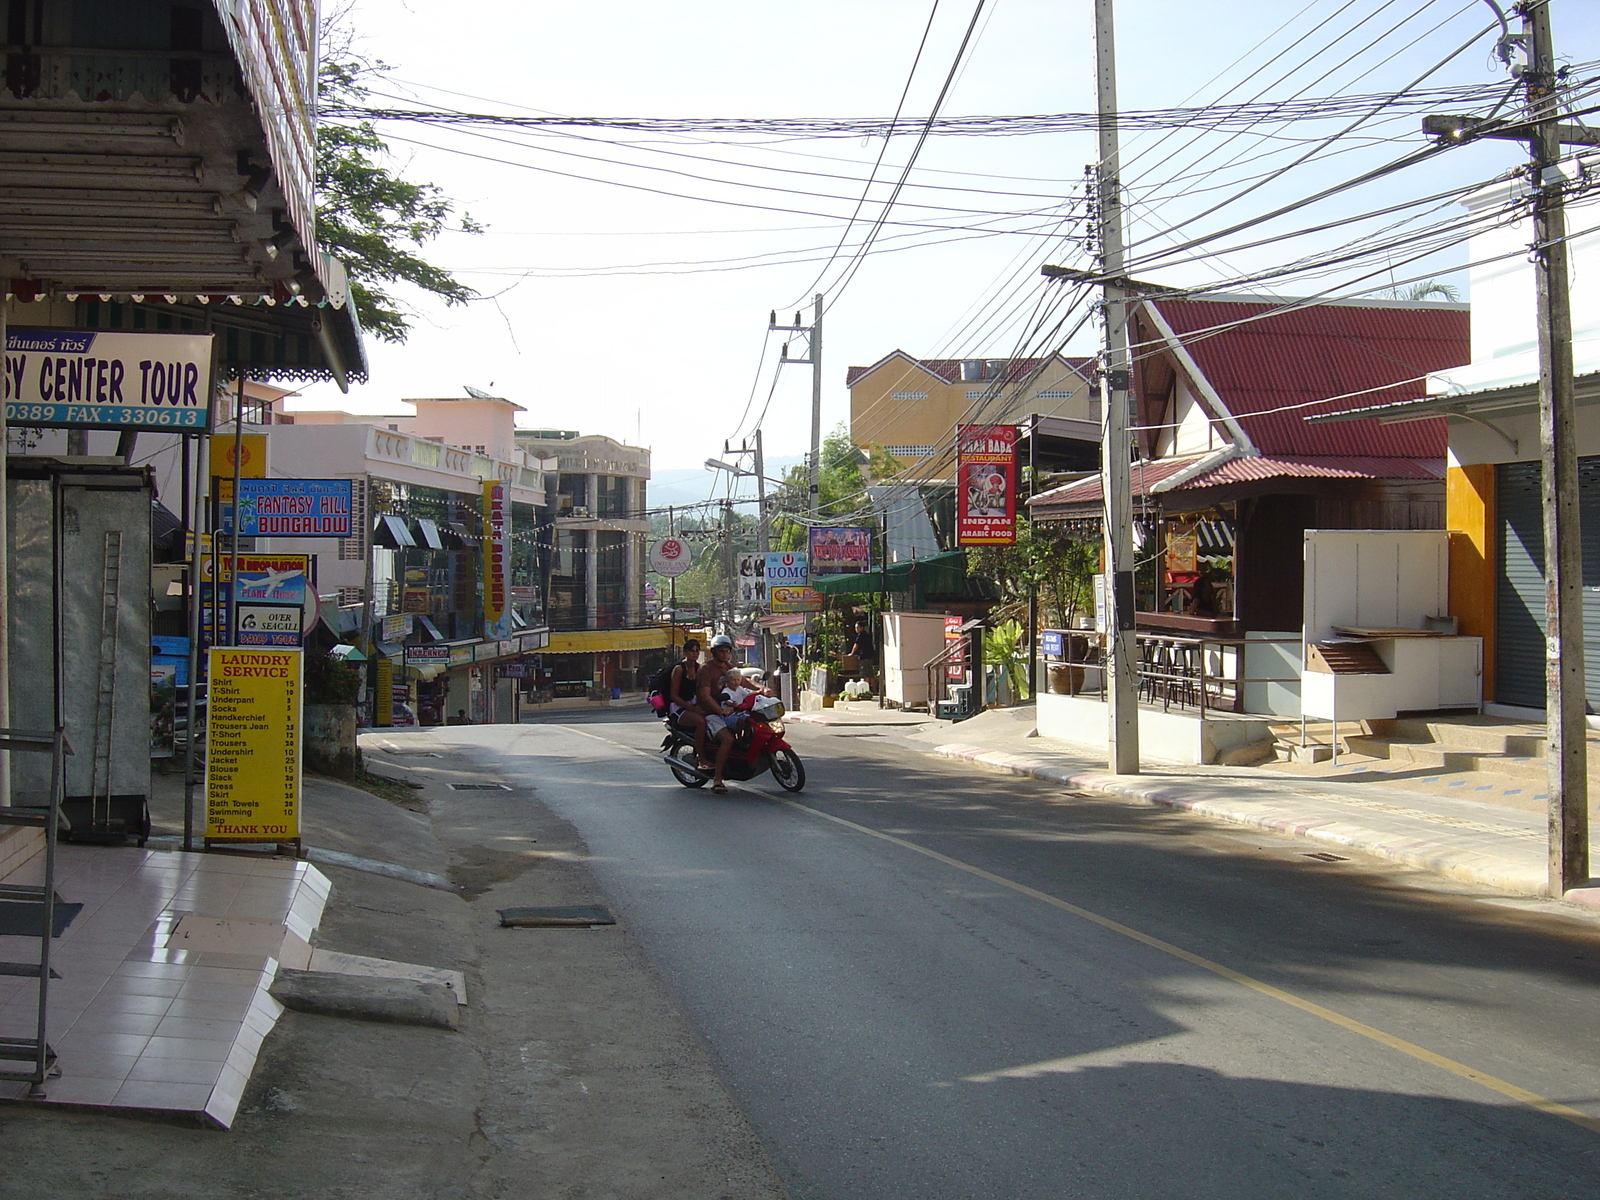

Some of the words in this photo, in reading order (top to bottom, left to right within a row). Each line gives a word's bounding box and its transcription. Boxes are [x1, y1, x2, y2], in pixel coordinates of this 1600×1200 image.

[39, 356, 125, 404] CENTER
[139, 360, 199, 407] TOUR
[66, 406, 101, 422] FAX
[120, 408, 198, 425] 330613
[988, 438, 1012, 453] BABA
[257, 496, 314, 515] FANTASY
[320, 496, 348, 514] HILL
[258, 516, 348, 534] BUNGALOW
[223, 556, 246, 571] TOR
[268, 614, 292, 622] OVER
[261, 622, 299, 630] SEACALL
[272, 636, 298, 645] TOUR
[220, 654, 292, 666] LAUNDRY
[223, 666, 289, 678] SERVICE
[212, 696, 254, 704] Underpant
[210, 808, 252, 817] Swimming
[210, 816, 225, 825] Slip
[215, 825, 258, 834] THANK
[262, 826, 288, 834] YOU
